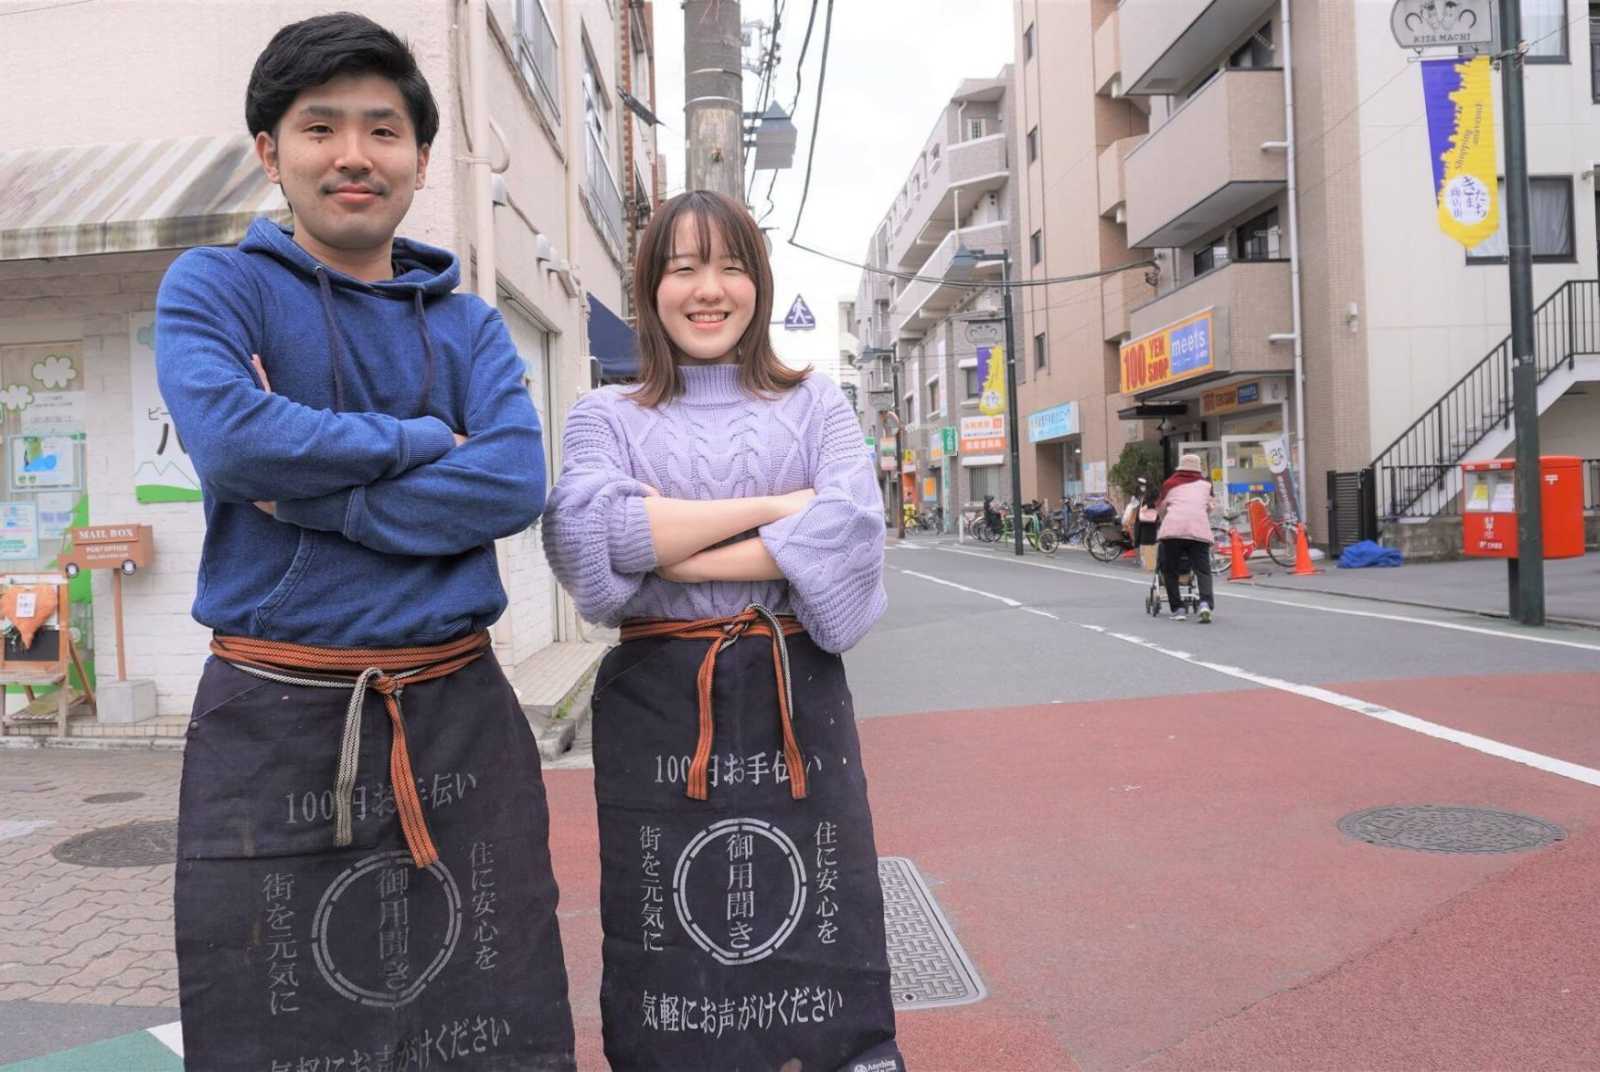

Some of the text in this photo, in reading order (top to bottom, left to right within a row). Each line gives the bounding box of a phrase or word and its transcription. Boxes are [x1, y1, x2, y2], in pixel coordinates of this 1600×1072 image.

[1125, 343, 1146, 390] 100
[1171, 328, 1205, 357] meets
[80, 528, 133, 538] MAIL BOX
[469, 841, 499, 971] 住に安心を
[640, 826, 664, 952] 街を元気に
[726, 833, 755, 949] 御用聞き
[816, 822, 838, 945] 住に安心を
[263, 872, 300, 1015] 街を元気に
[642, 986, 843, 1039] 気軽にお声がけください
